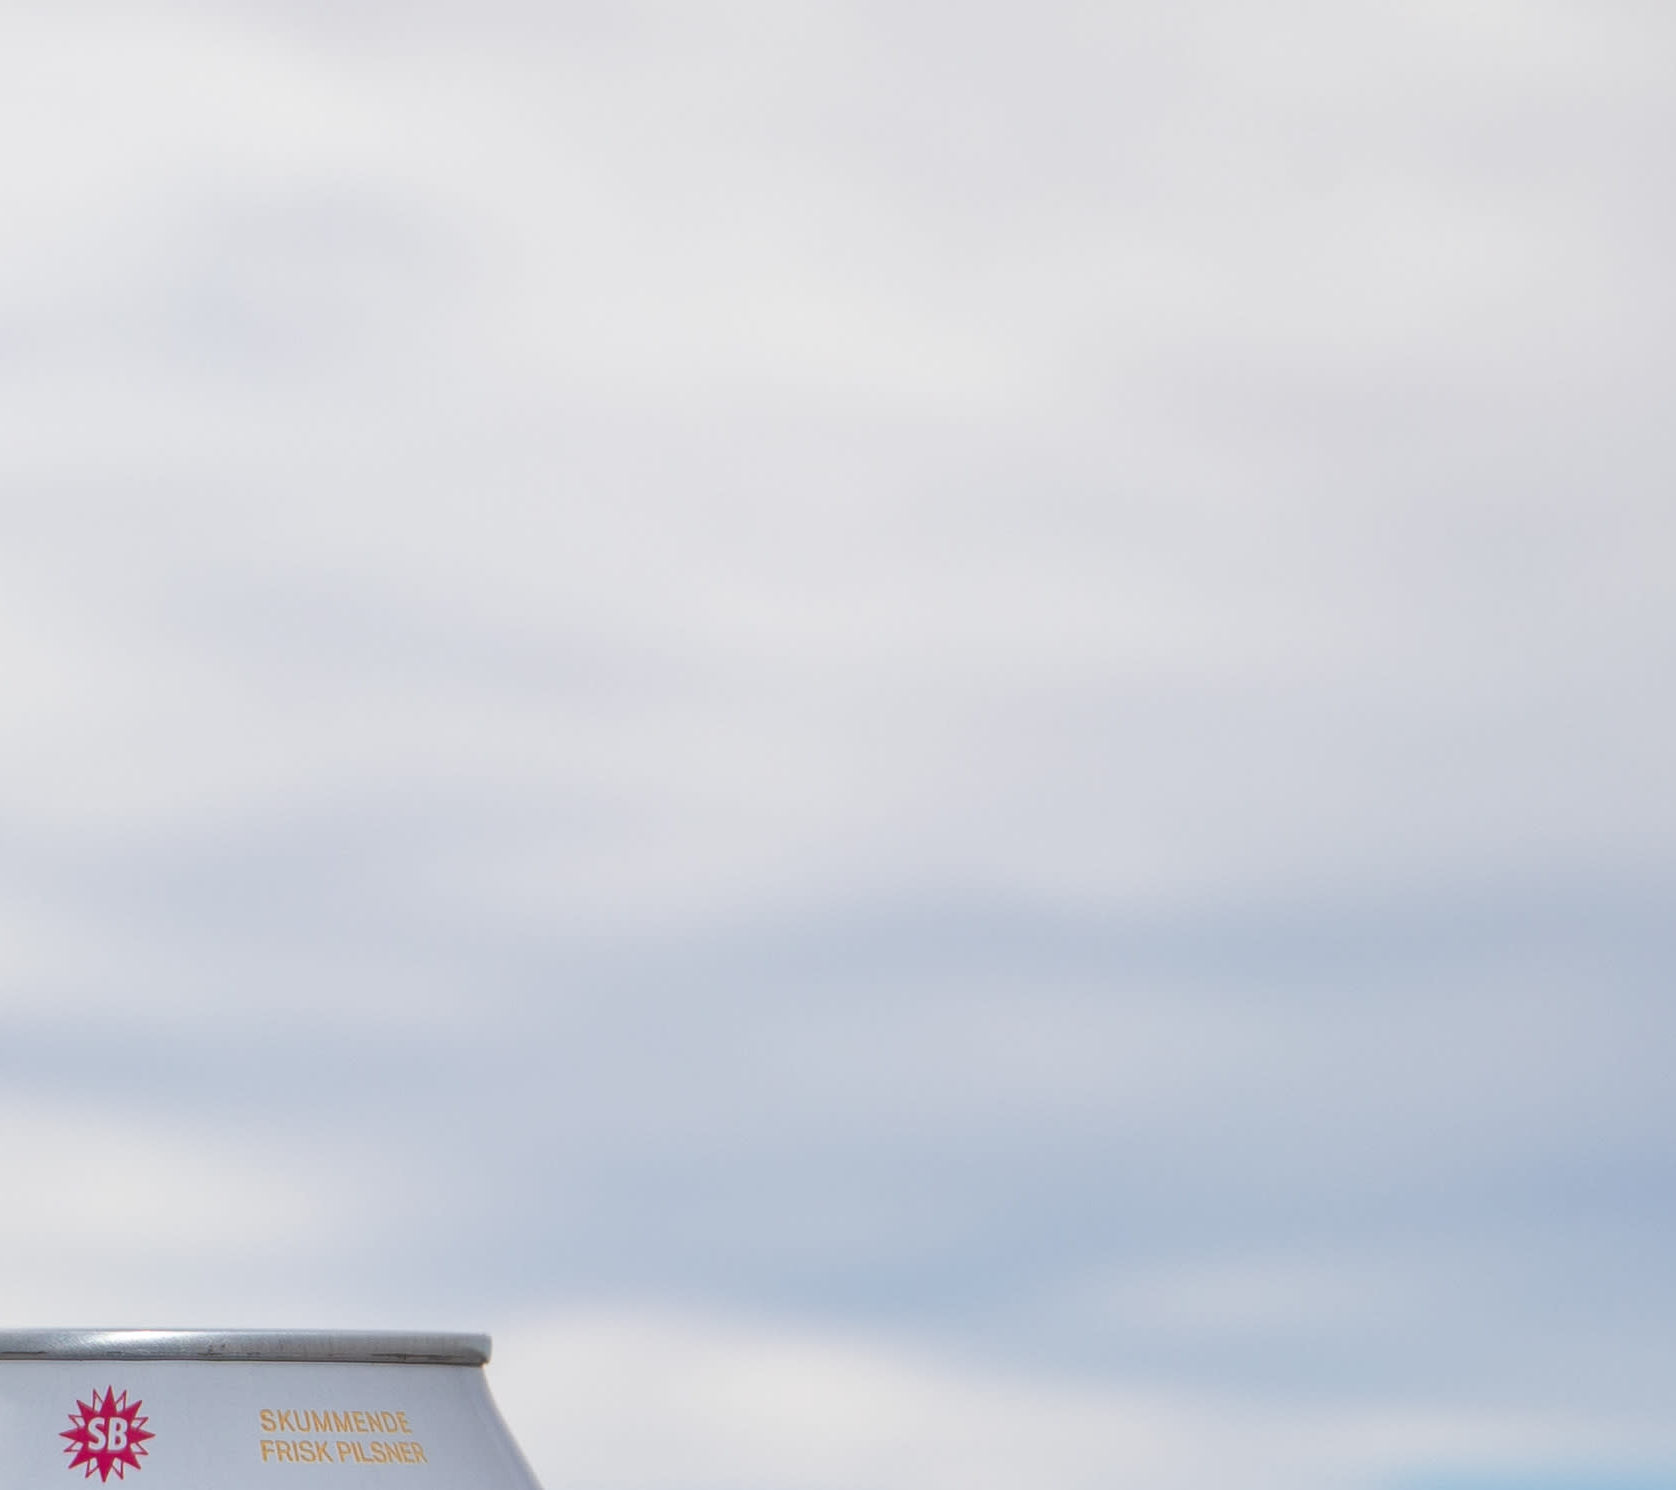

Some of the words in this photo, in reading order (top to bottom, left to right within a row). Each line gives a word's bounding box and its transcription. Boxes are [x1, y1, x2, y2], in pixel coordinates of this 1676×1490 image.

[87, 1416, 129, 1452] SB
[259, 1408, 414, 1434] SKUMMENDE
[259, 1439, 334, 1464] FRISK
[335, 1440, 429, 1464] PILSNER
